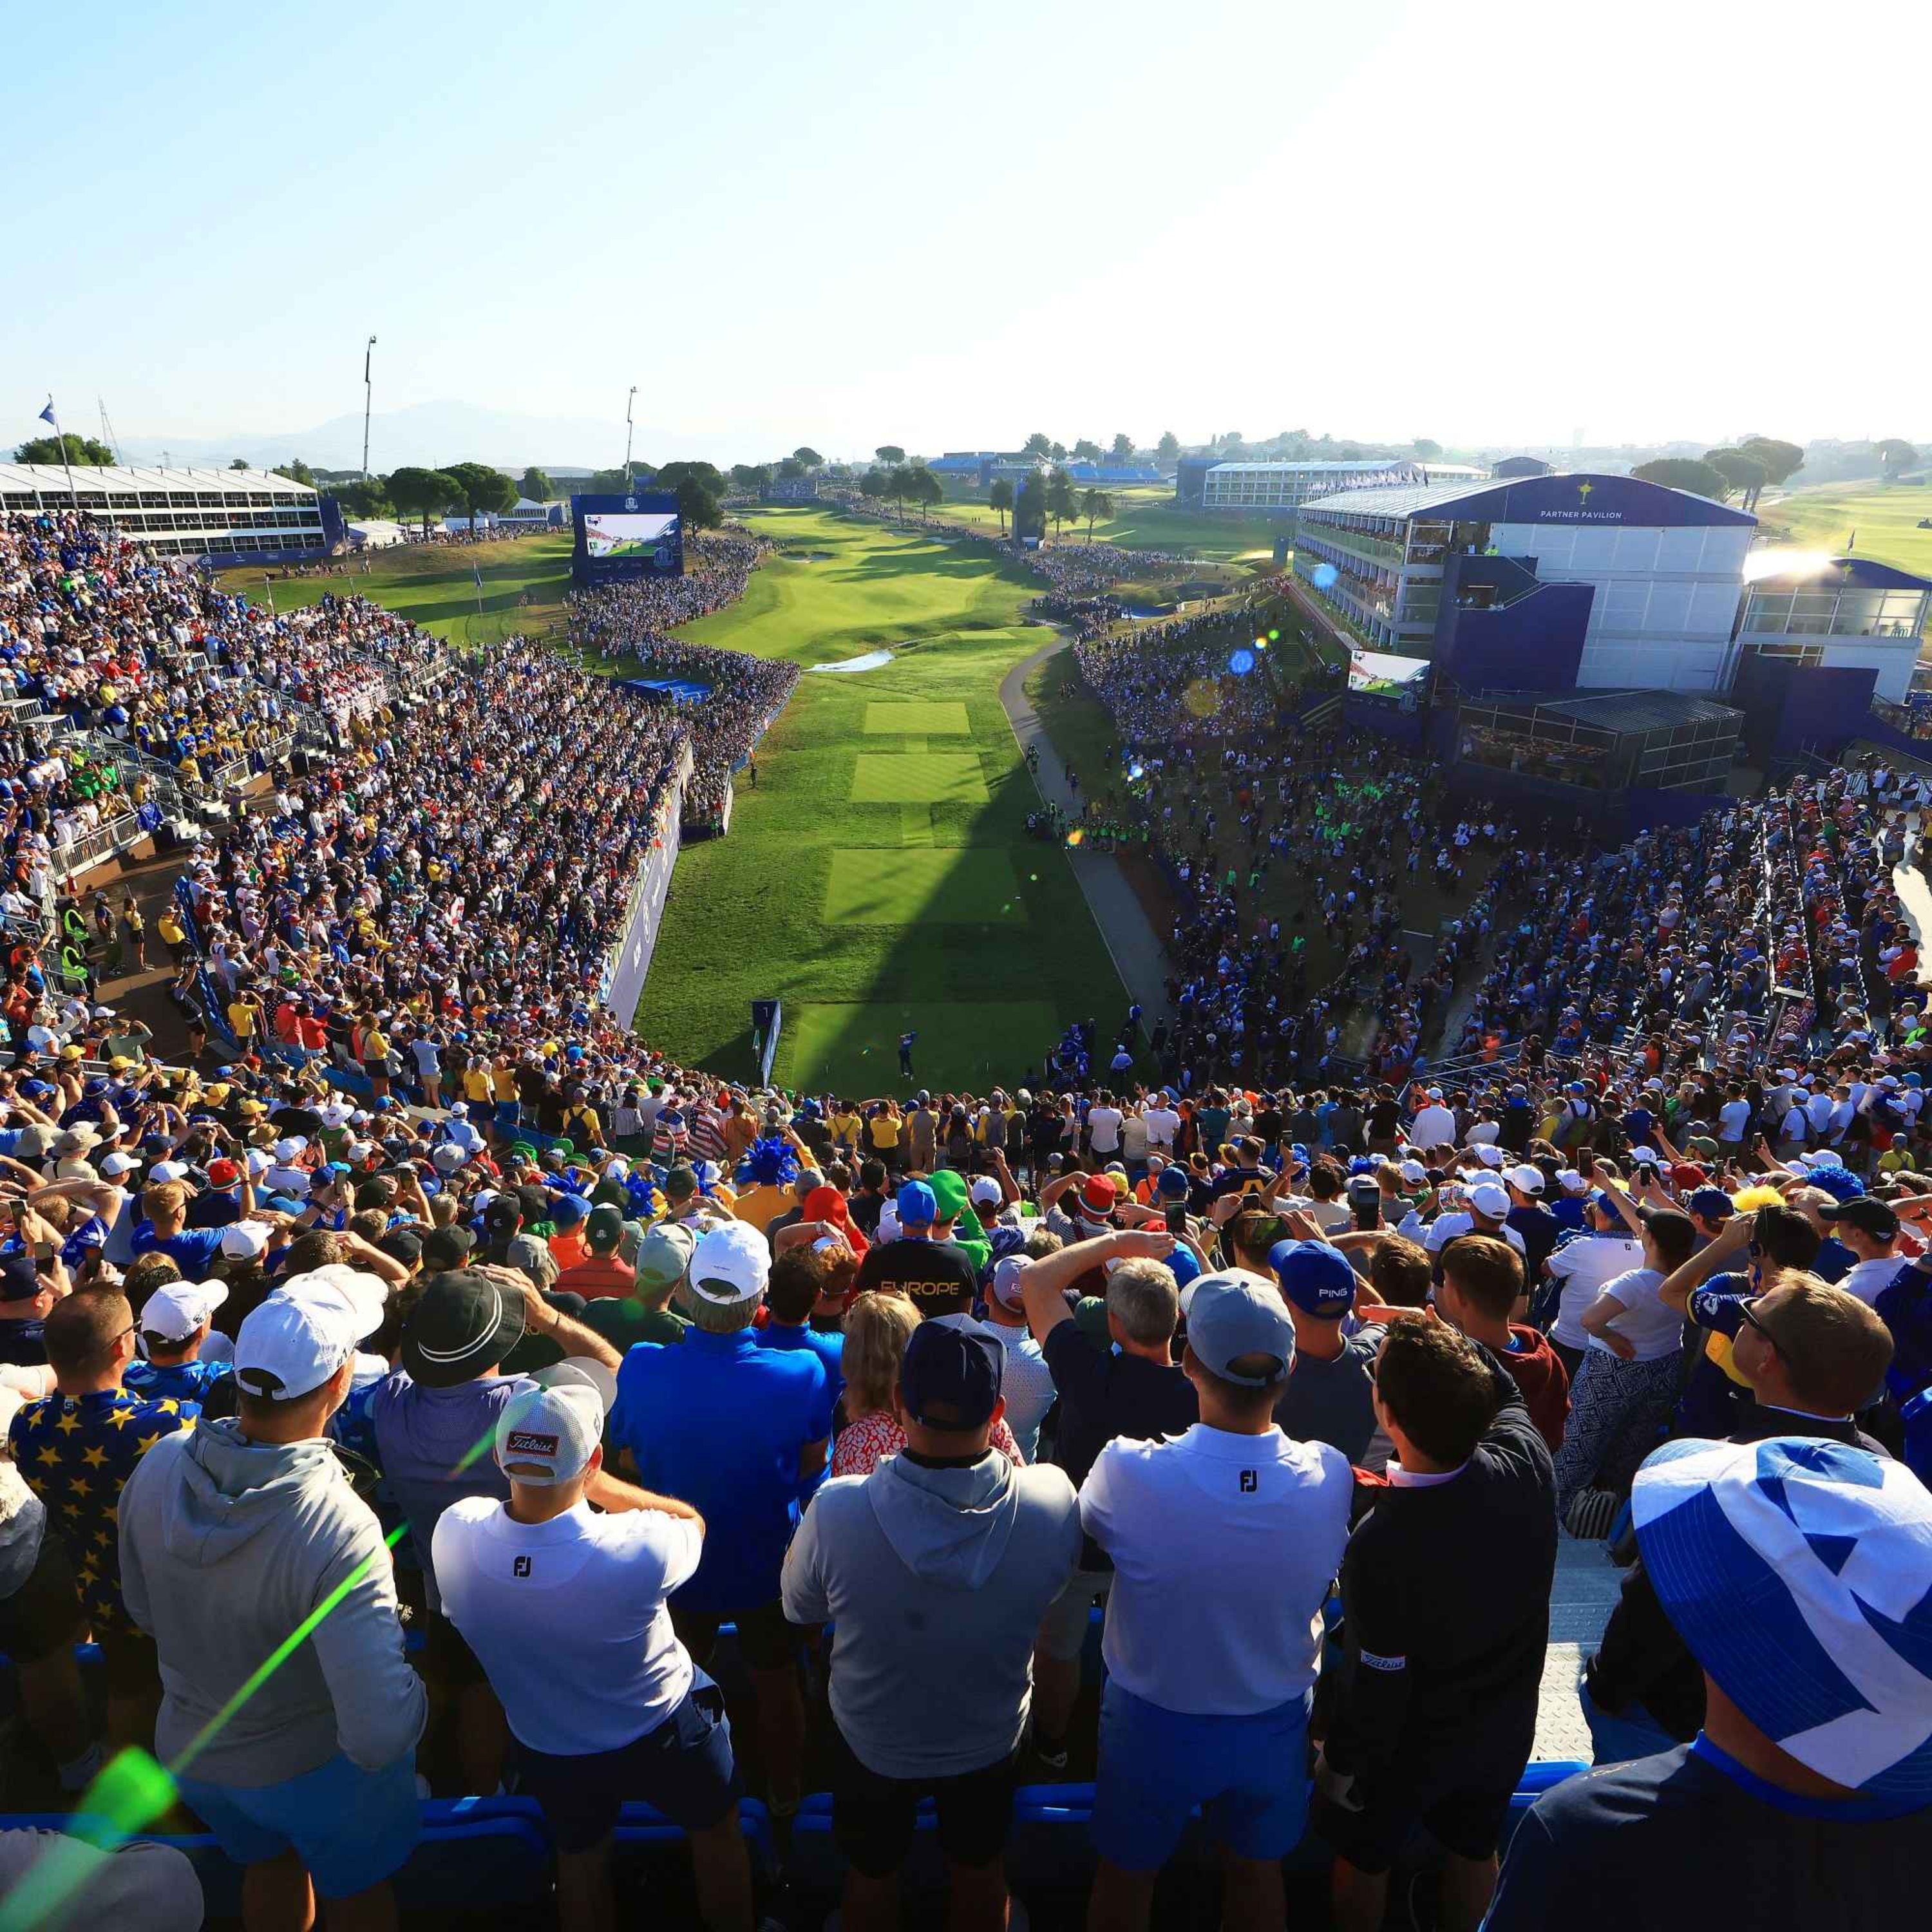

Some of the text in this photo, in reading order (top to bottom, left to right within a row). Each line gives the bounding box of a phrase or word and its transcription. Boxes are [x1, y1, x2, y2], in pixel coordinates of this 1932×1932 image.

[1319, 1287, 1347, 1298] PING
[509, 1435, 554, 1453] Titleist
[1240, 1470, 1257, 1492] FJ
[513, 1556, 531, 1577] FJ
